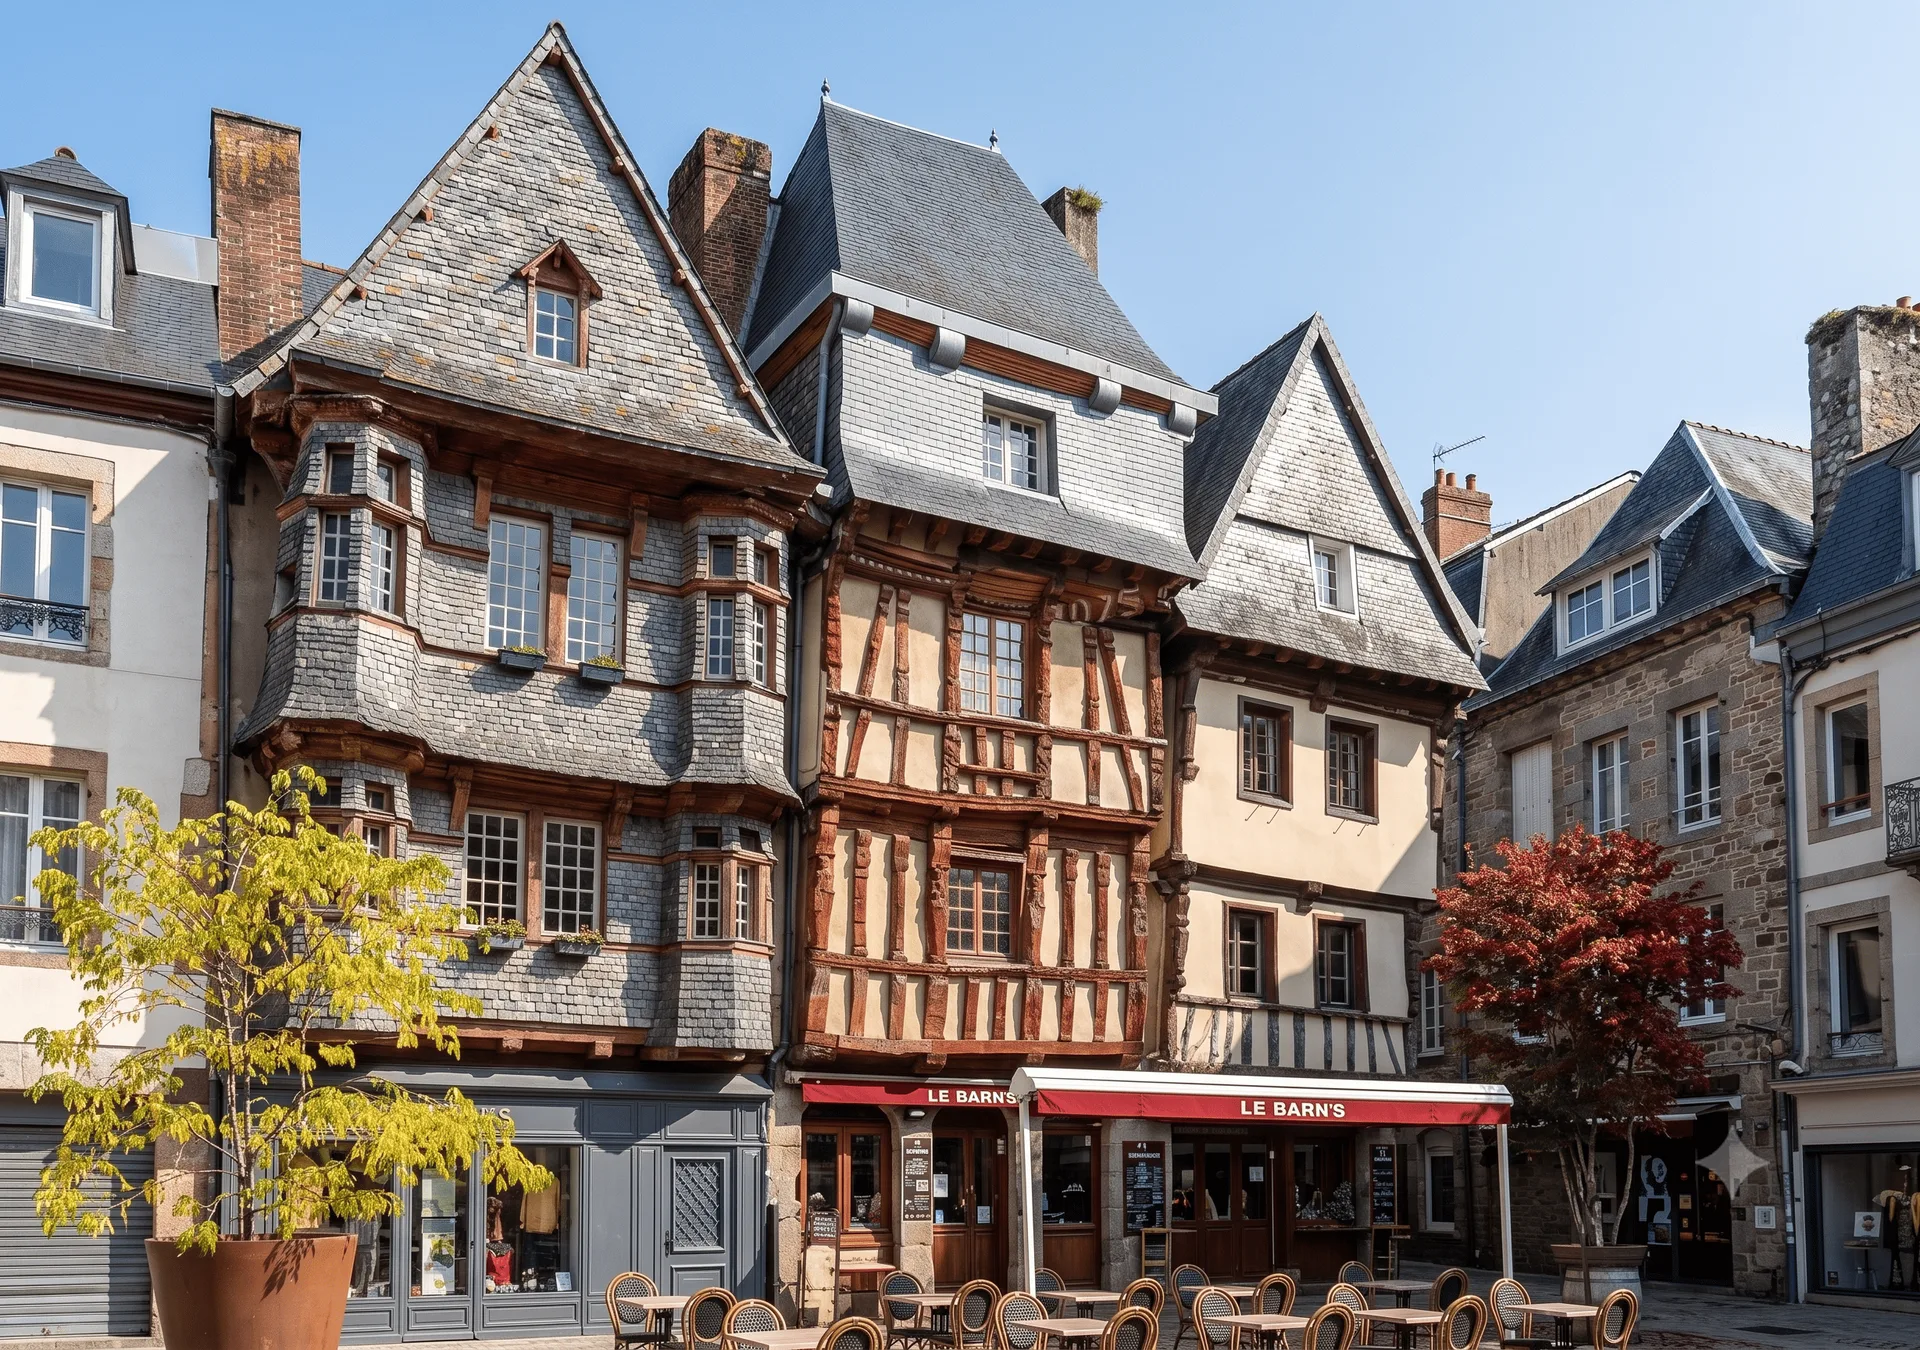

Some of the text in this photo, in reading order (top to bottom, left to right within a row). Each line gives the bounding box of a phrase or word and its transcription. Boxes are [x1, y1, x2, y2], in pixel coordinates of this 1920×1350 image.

[928, 1089, 1017, 1104] LE BARN'S
[1241, 1100, 1346, 1118] LE BARN'S
